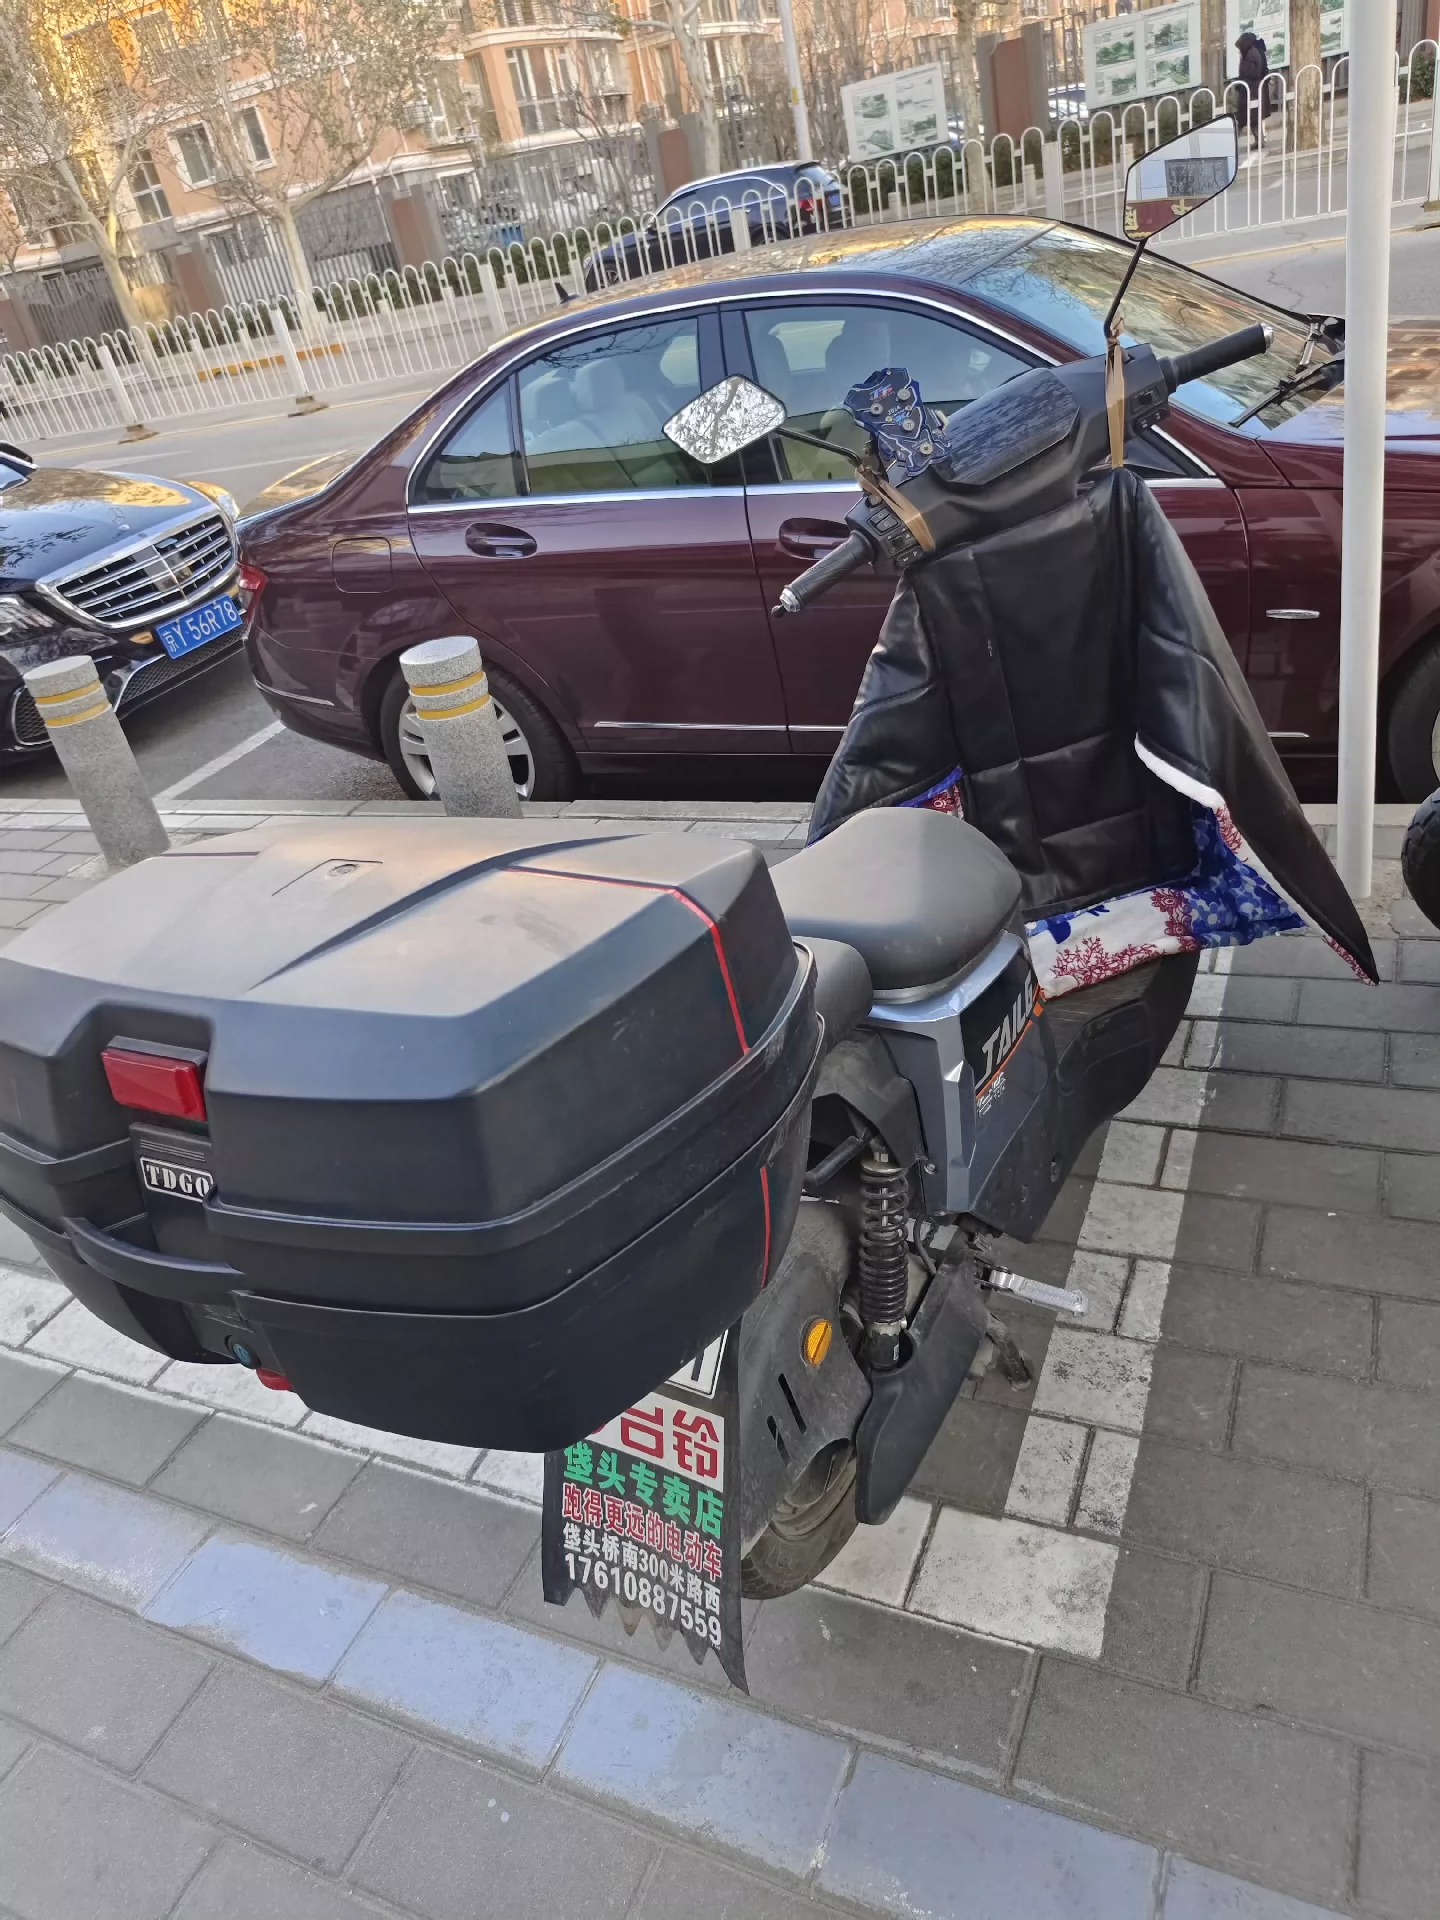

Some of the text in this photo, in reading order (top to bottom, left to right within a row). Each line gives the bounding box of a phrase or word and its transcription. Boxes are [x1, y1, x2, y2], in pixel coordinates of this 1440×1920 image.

[145, 1163, 210, 1198] TDGO
[620, 1405, 721, 1480] 台铃
[562, 1482, 723, 1582] 跑得更远的电动车
[563, 1440, 724, 1540] 垡头专卖店
[562, 1522, 722, 1615] 垡头桥南300米路西
[563, 1553, 722, 1647] 17610887559
